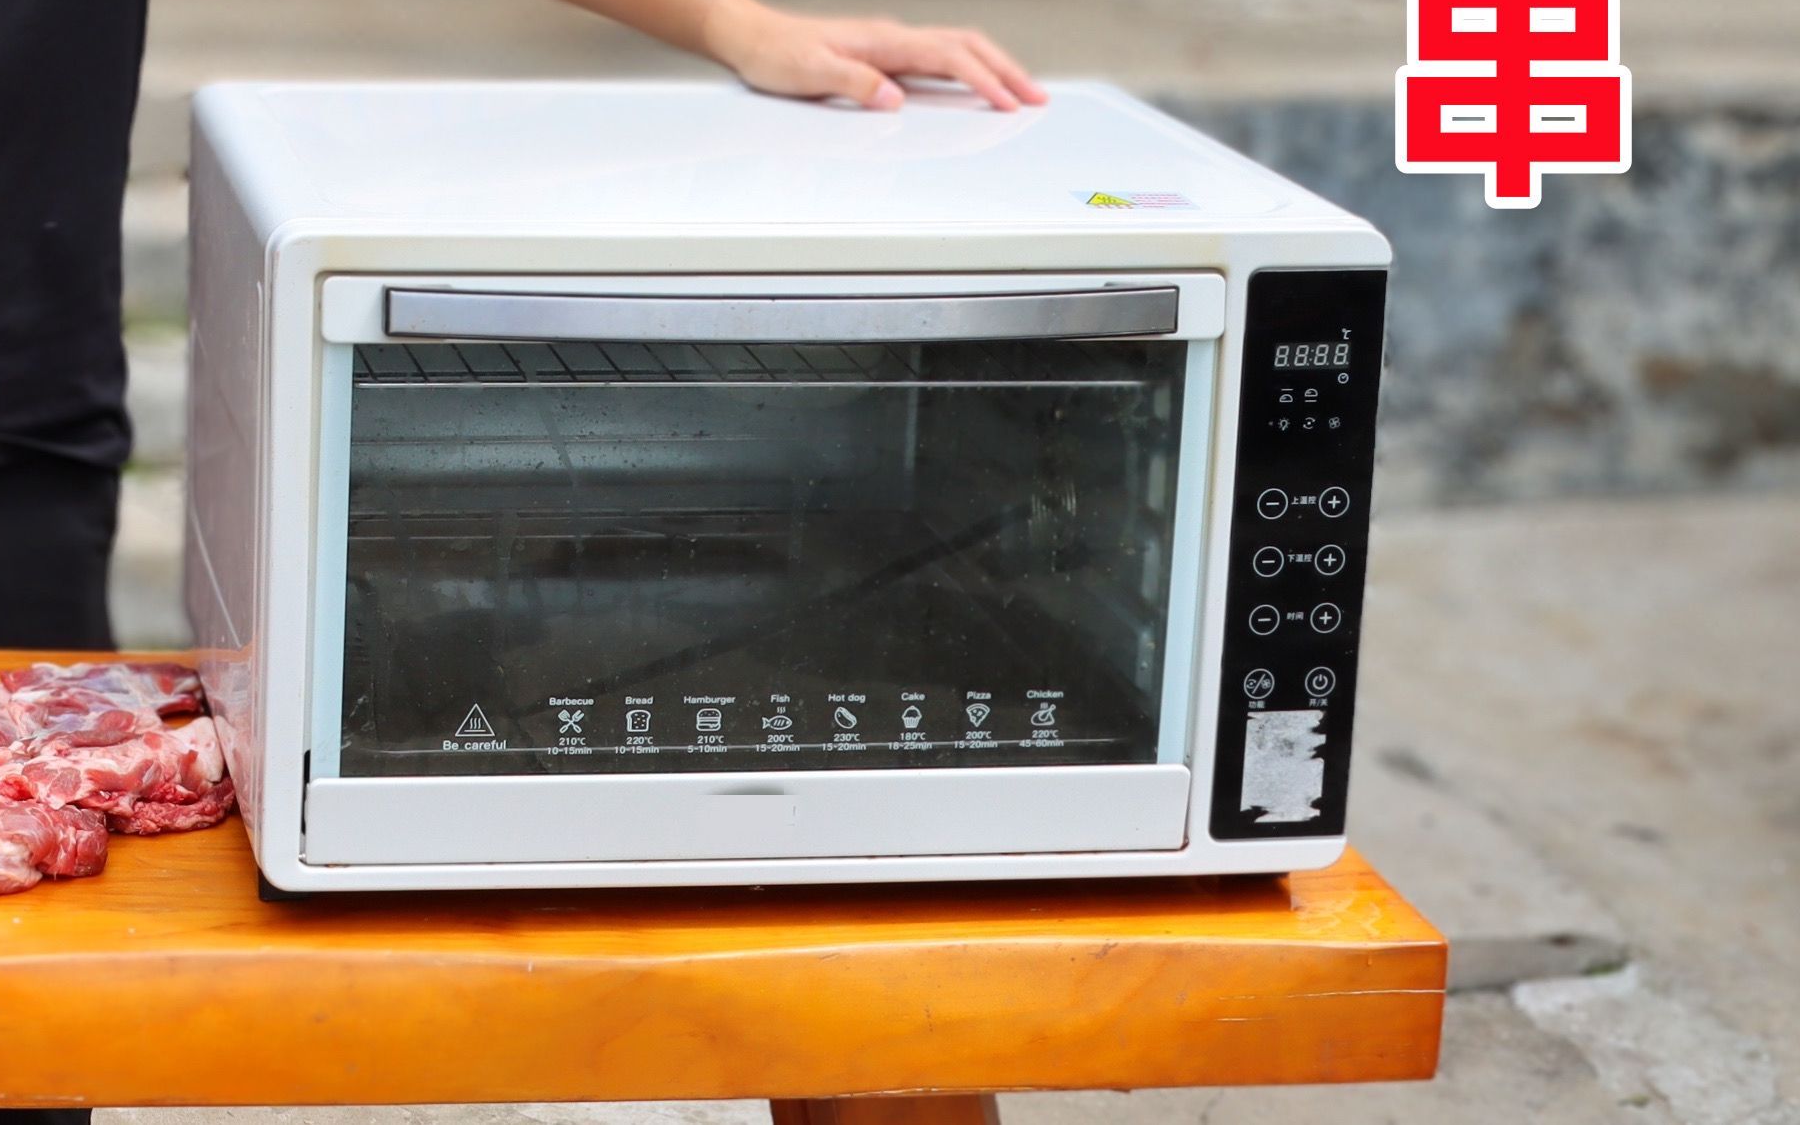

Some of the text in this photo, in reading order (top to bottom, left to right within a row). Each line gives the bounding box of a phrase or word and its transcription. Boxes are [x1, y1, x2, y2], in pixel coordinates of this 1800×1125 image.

[1291, 495, 1317, 505] 上温控
[1287, 553, 1313, 563] 下温控
[1286, 611, 1304, 621] 时间
[770, 694, 791, 703] Fish
[827, 693, 866, 704] Hot dog
[900, 692, 926, 701] Cake
[966, 691, 992, 700] Pizza
[1025, 690, 1064, 699] Chicken
[548, 696, 595, 706] Barbecue
[625, 695, 654, 705] Bread
[683, 694, 736, 706] Hamburger
[442, 739, 507, 751] Be careful
